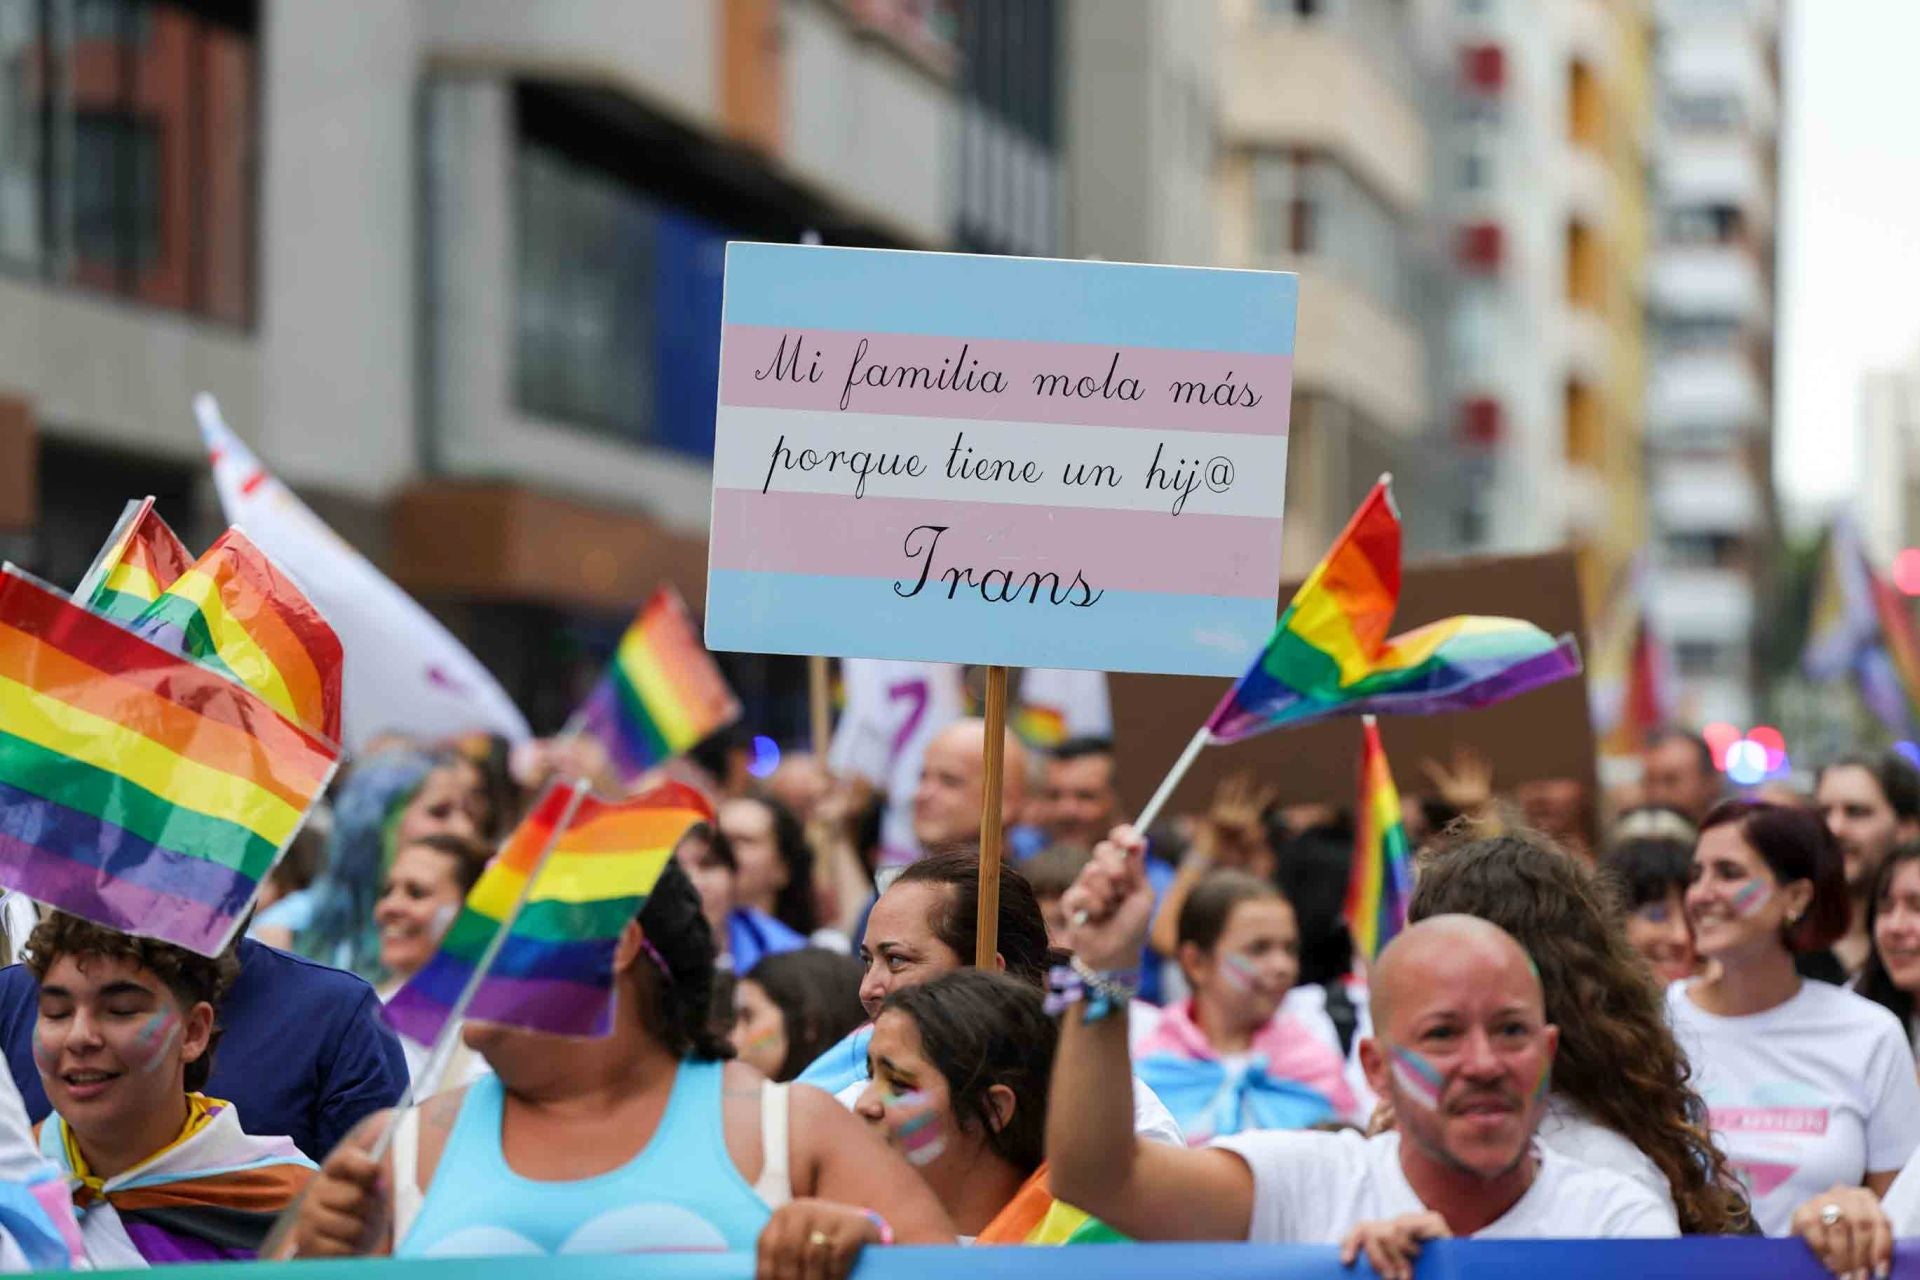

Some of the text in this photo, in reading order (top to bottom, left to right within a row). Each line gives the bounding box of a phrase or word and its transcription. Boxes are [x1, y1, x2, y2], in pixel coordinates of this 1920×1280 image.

[753, 333, 1263, 411] Mi familia mola más
[762, 431, 1235, 517] porque tiene un hij@
[893, 525, 1105, 608] Trans
